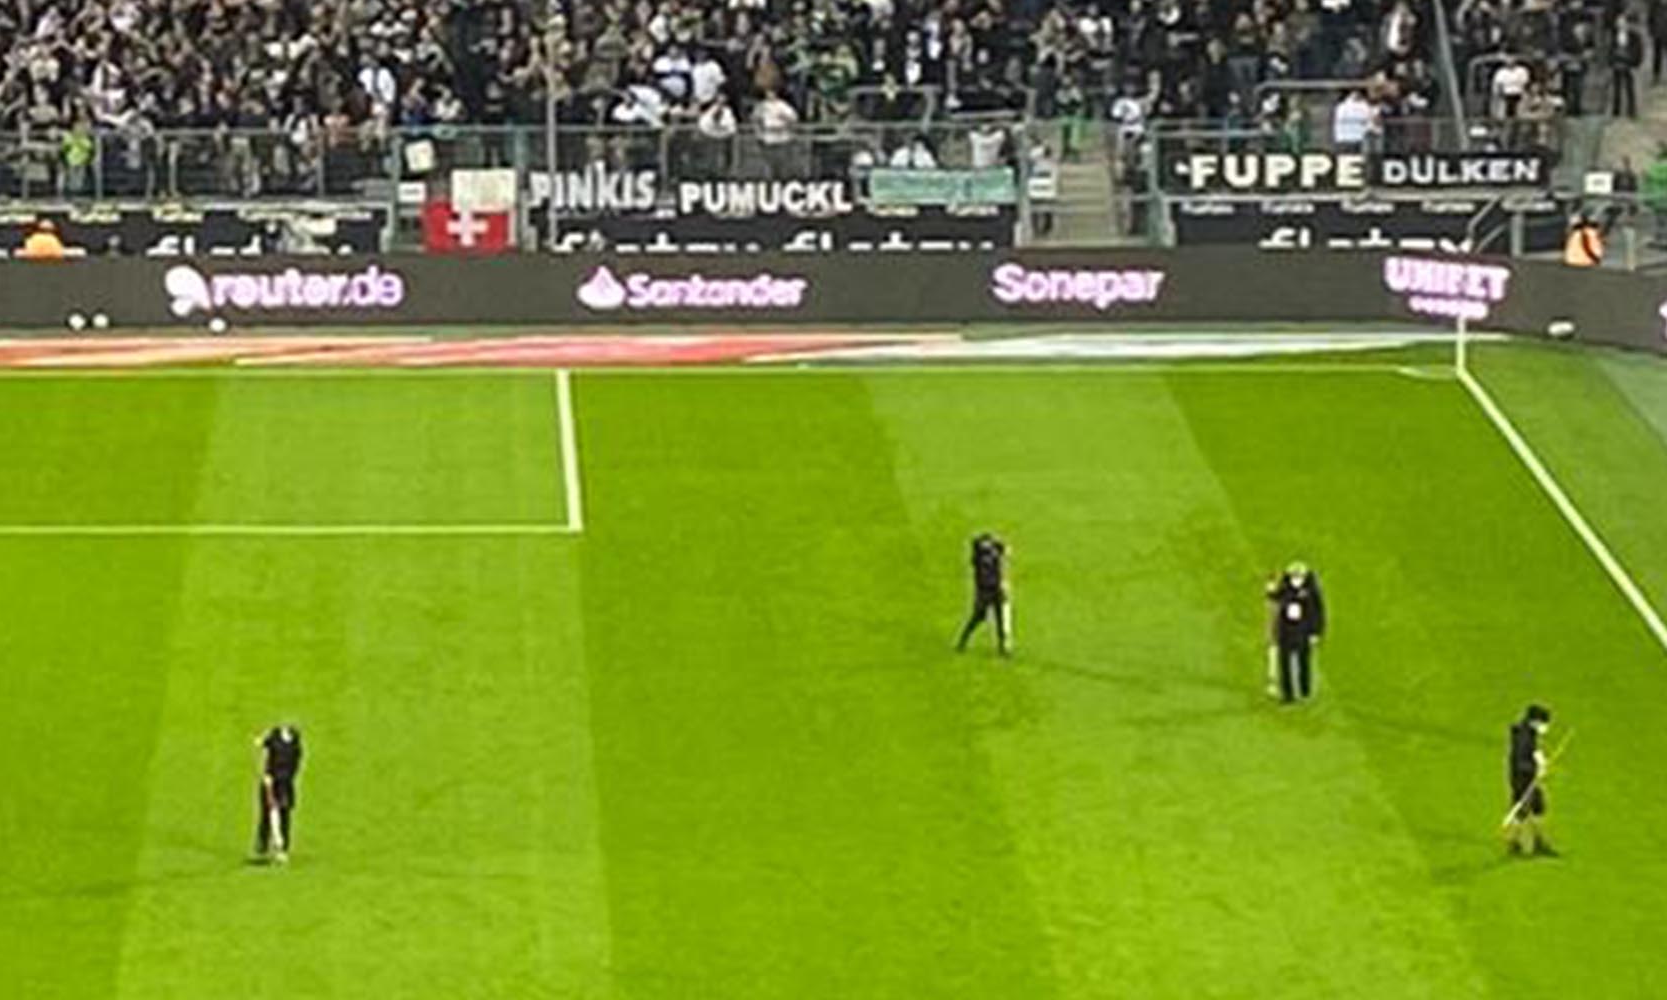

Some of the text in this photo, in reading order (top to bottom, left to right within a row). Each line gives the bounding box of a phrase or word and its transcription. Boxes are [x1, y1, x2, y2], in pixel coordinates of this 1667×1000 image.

[679, 181, 853, 213] PUMUCKL
[211, 265, 404, 306] reuter.de
[627, 273, 809, 306] Santander
[992, 263, 1165, 309] Sonepar
